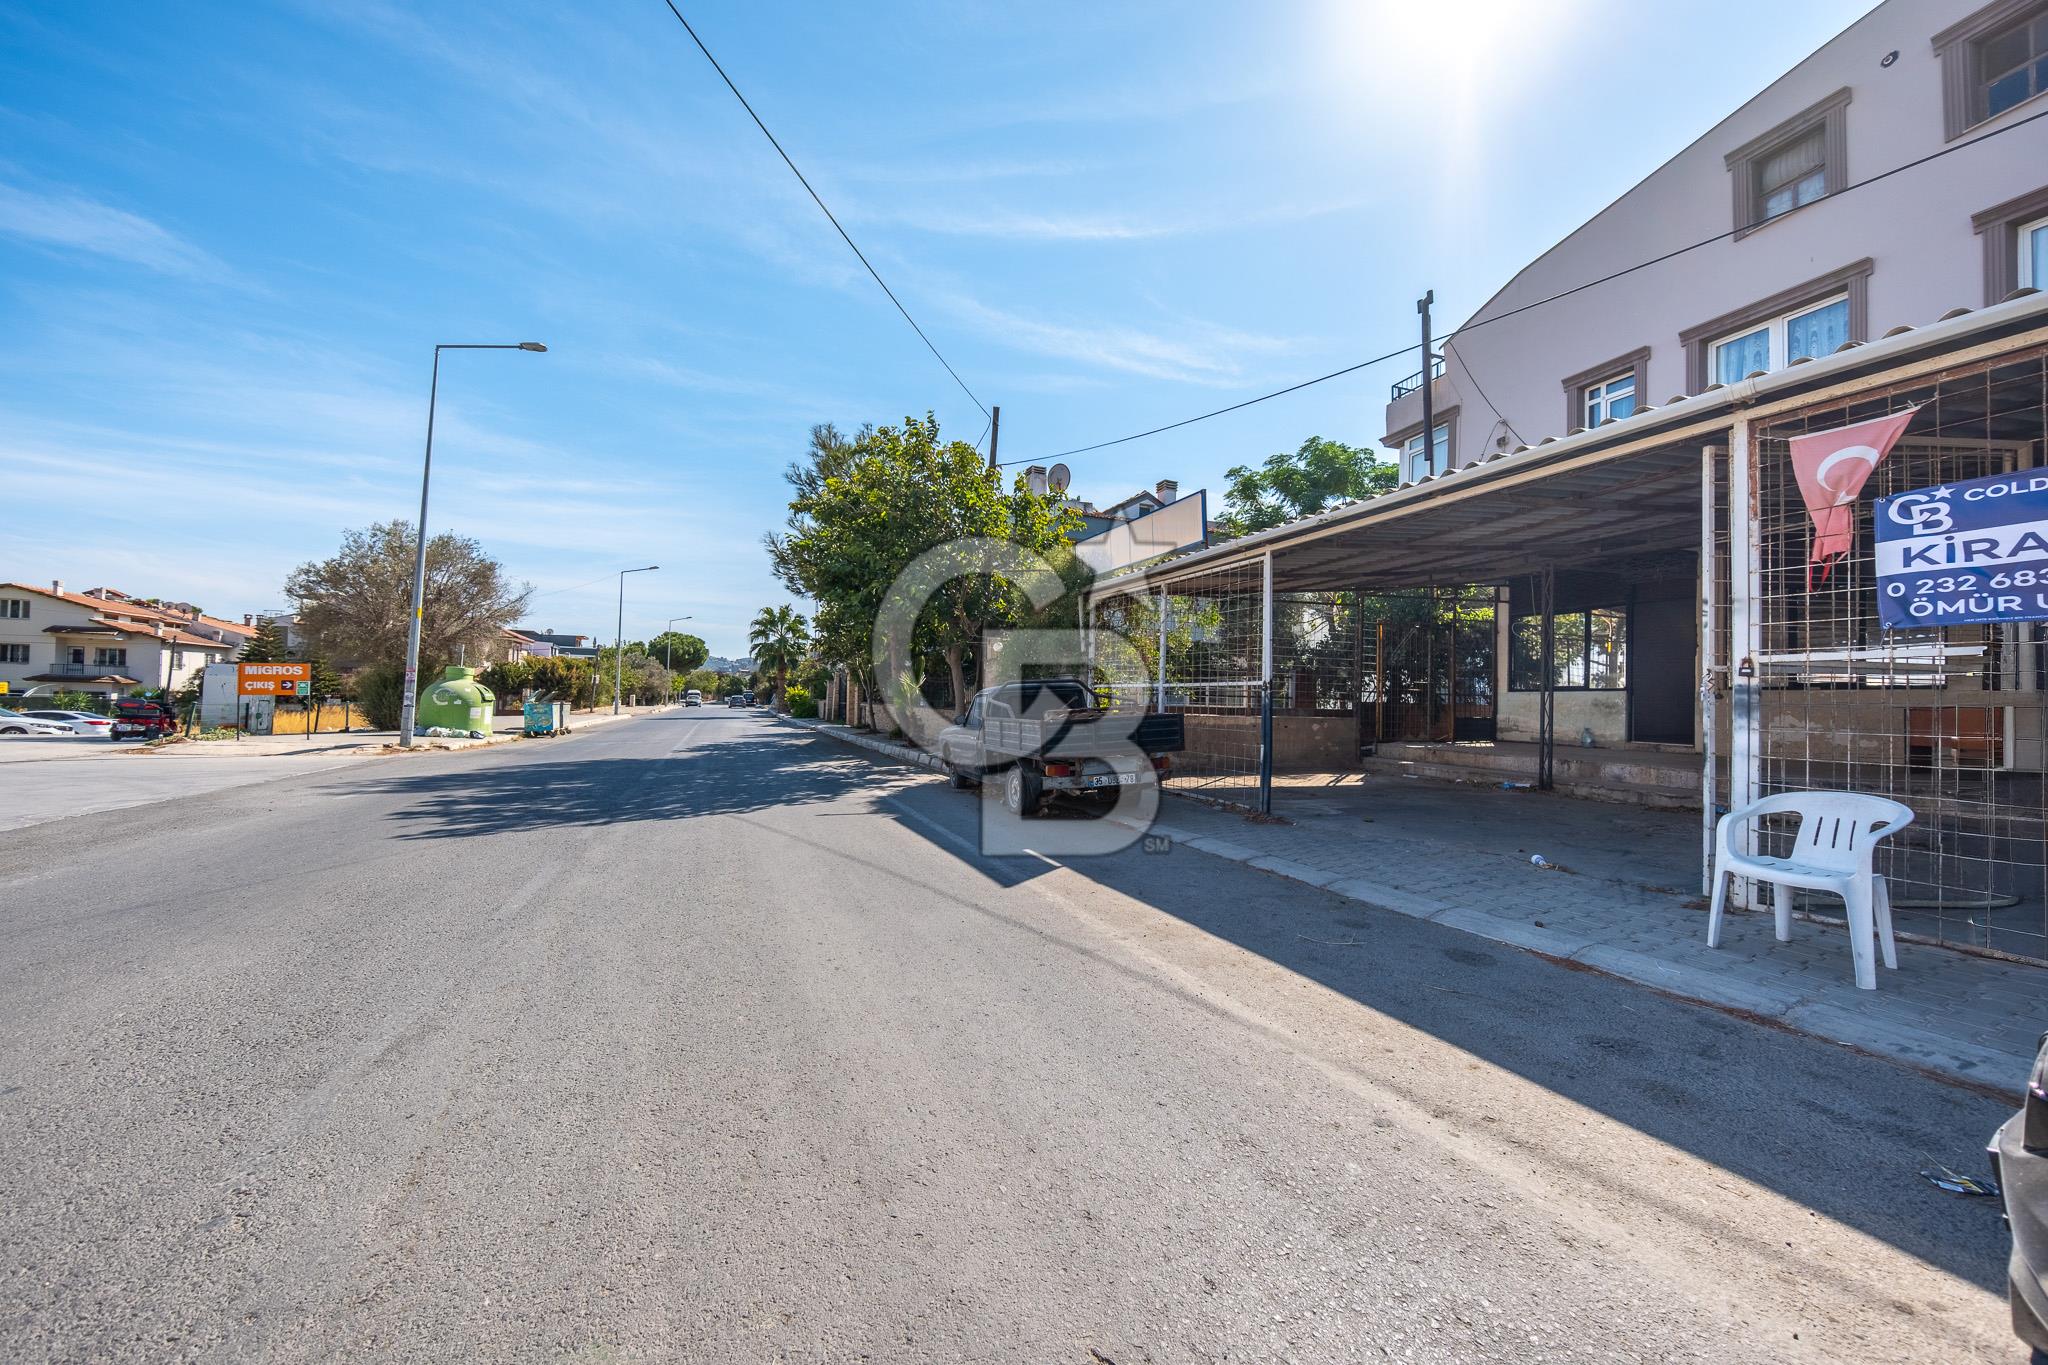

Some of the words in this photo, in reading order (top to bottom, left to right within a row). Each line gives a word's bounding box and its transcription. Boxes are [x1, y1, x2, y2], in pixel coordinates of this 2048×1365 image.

[1886, 582, 1906, 597] 0
[1916, 575, 1977, 595] 232
[1909, 593, 2024, 617] ÖMÜR
[244, 681, 276, 691] ÇIKIŞ
[1094, 776, 1103, 786] 35
